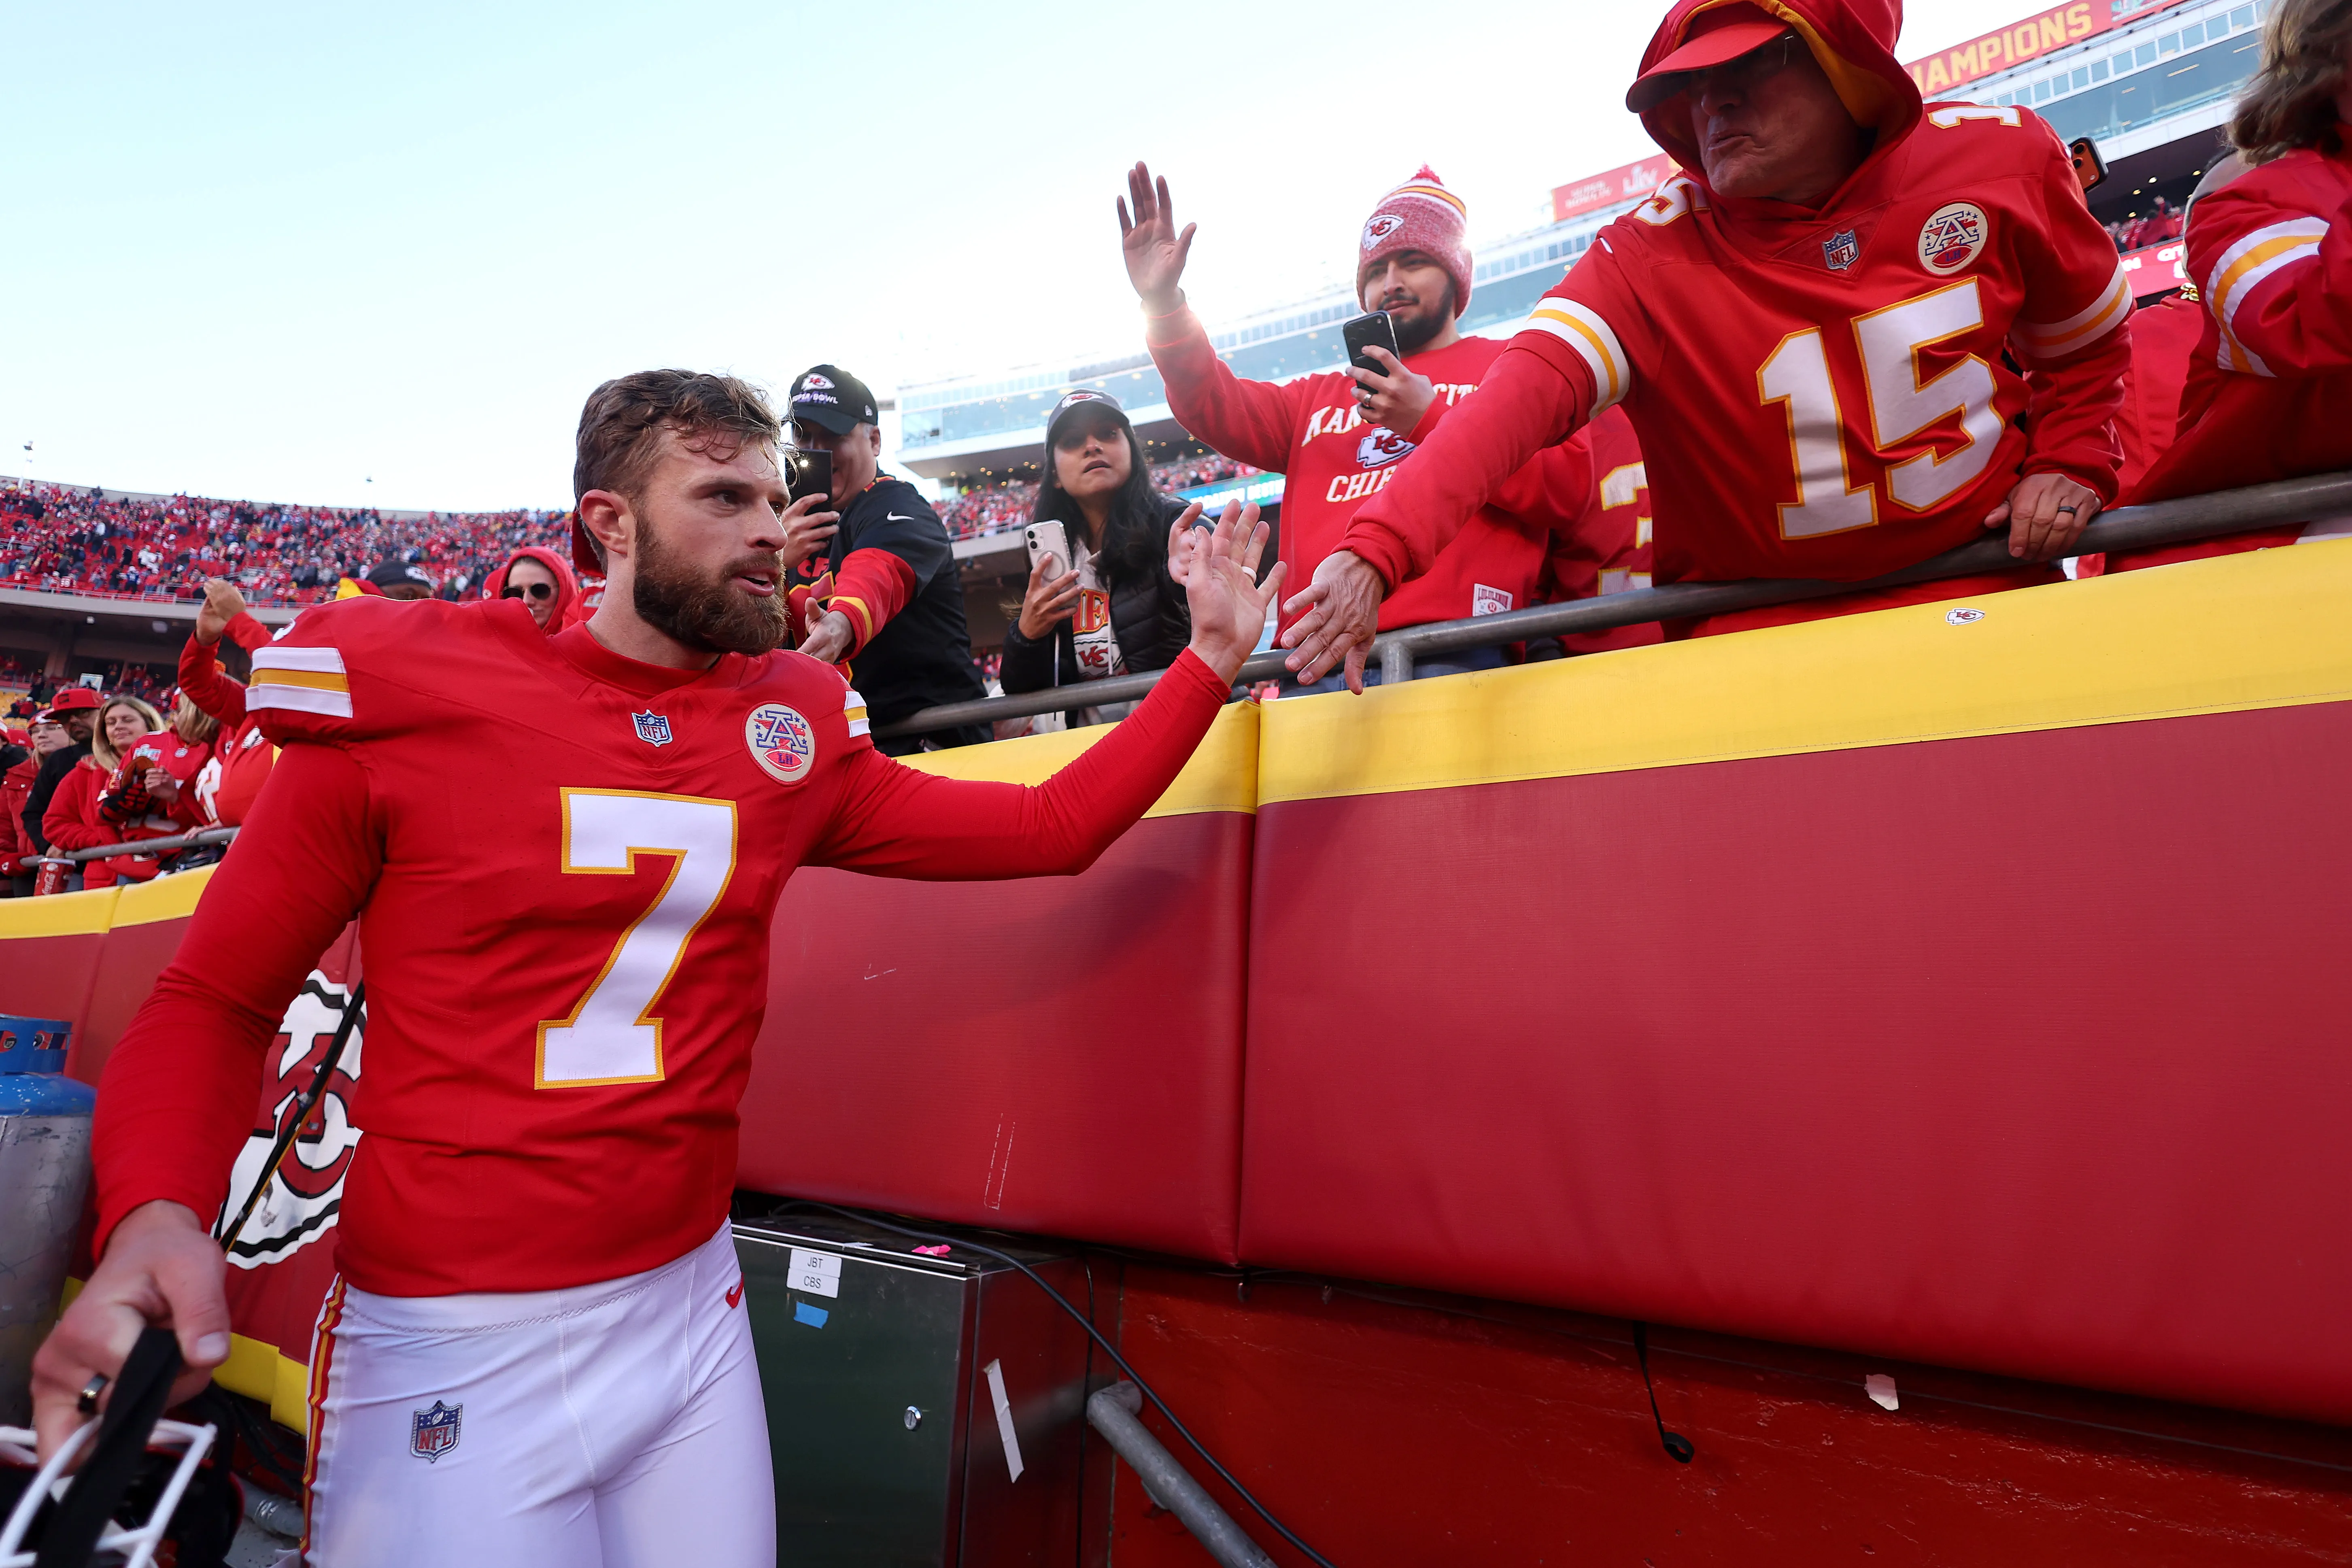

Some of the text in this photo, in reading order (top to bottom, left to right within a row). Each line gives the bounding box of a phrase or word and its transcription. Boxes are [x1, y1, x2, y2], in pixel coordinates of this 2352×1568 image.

[1907, 2, 2093, 93] HAMPIONS
[1830, 245, 1855, 264] NFL
[1945, 250, 1961, 262] LH
[813, 393, 839, 404] BOWL
[1301, 382, 1478, 447] KAN CIT
[1756, 276, 2006, 540] 15
[1326, 465, 1398, 503] CHIE
[1955, 611, 1976, 620] KC
[642, 725, 667, 739] NFL
[778, 753, 793, 765] LH
[534, 787, 739, 1090] 7
[807, 1256, 824, 1269] JBT
[803, 1275, 822, 1289] CBS
[418, 1426, 453, 1451] NFL
